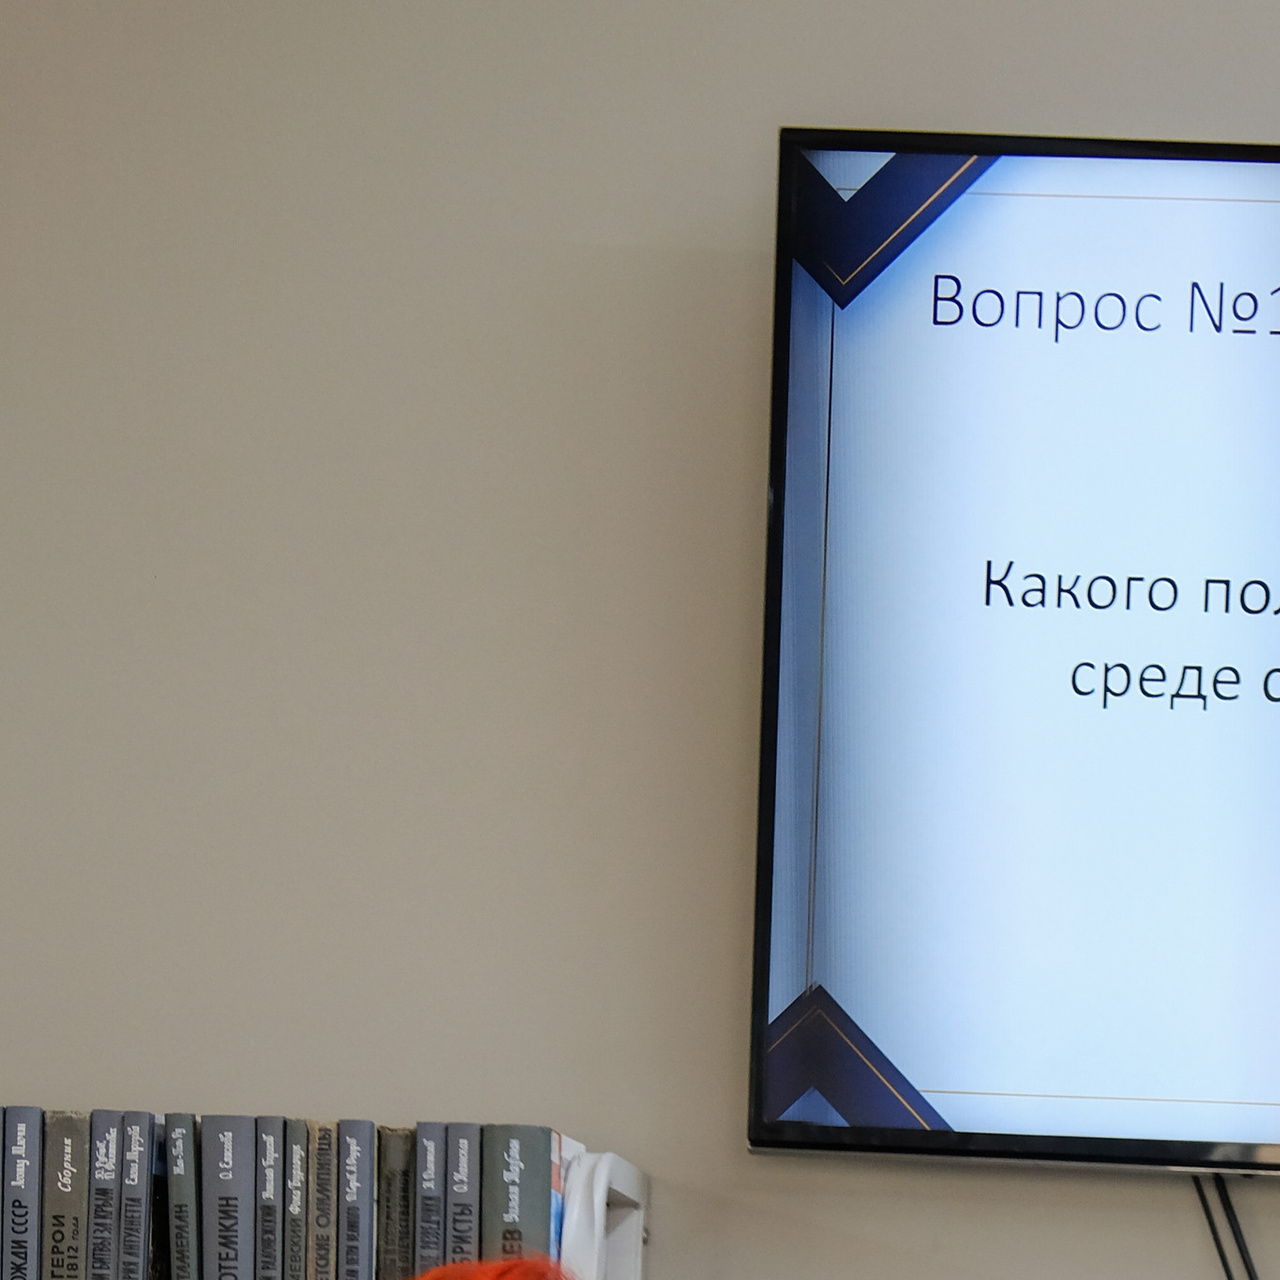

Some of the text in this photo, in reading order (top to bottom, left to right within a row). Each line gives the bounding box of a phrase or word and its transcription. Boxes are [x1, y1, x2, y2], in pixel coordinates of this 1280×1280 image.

[932, 273, 1162, 343] Вопрос
[984, 558, 1178, 613] Какого
[1071, 660, 1241, 711] среде
[57, 1137, 77, 1192] Сборник
[315, 1128, 332, 1228] ОЛИМПИЙЦЫ
[11, 1199, 29, 1235] СССР
[94, 1188, 114, 1220] КРЫМ
[124, 1197, 142, 1258] АНТУАНЕТТА
[51, 1214, 66, 1279] ГЕРОИ
[93, 1236, 112, 1270] БИТВЫ
[452, 1203, 473, 1262] БРИСТЫ
[66, 1246, 79, 1279] 1812
